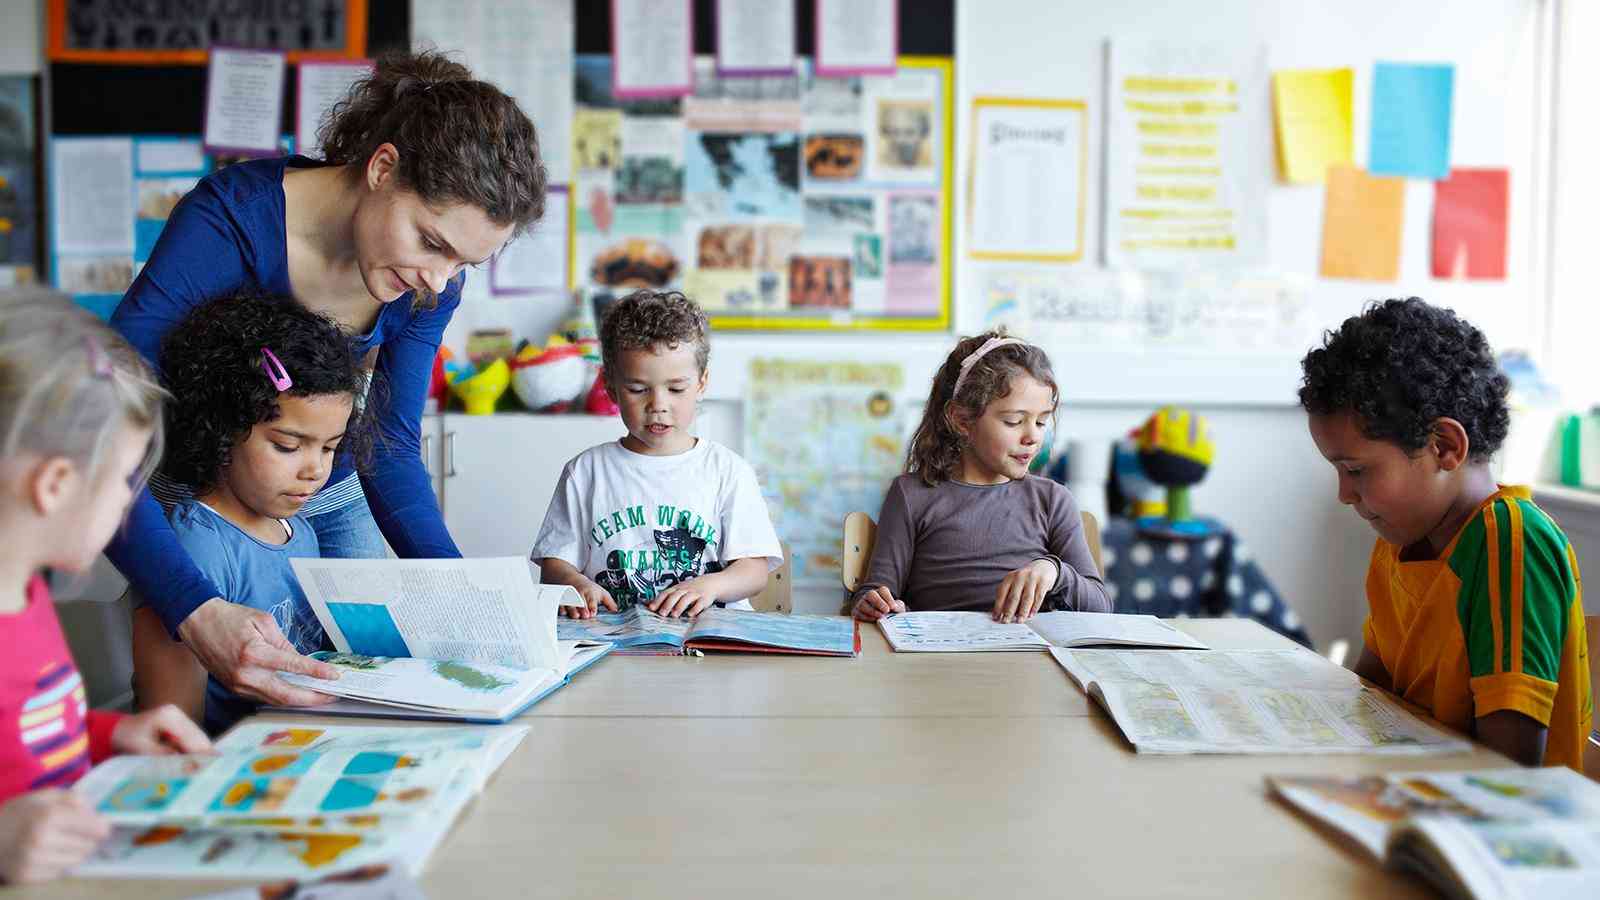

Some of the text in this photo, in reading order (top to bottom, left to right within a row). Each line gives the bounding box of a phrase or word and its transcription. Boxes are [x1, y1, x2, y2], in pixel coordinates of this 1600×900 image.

[592, 505, 717, 547] TEAM WORK
[619, 550, 692, 570] MAKES
